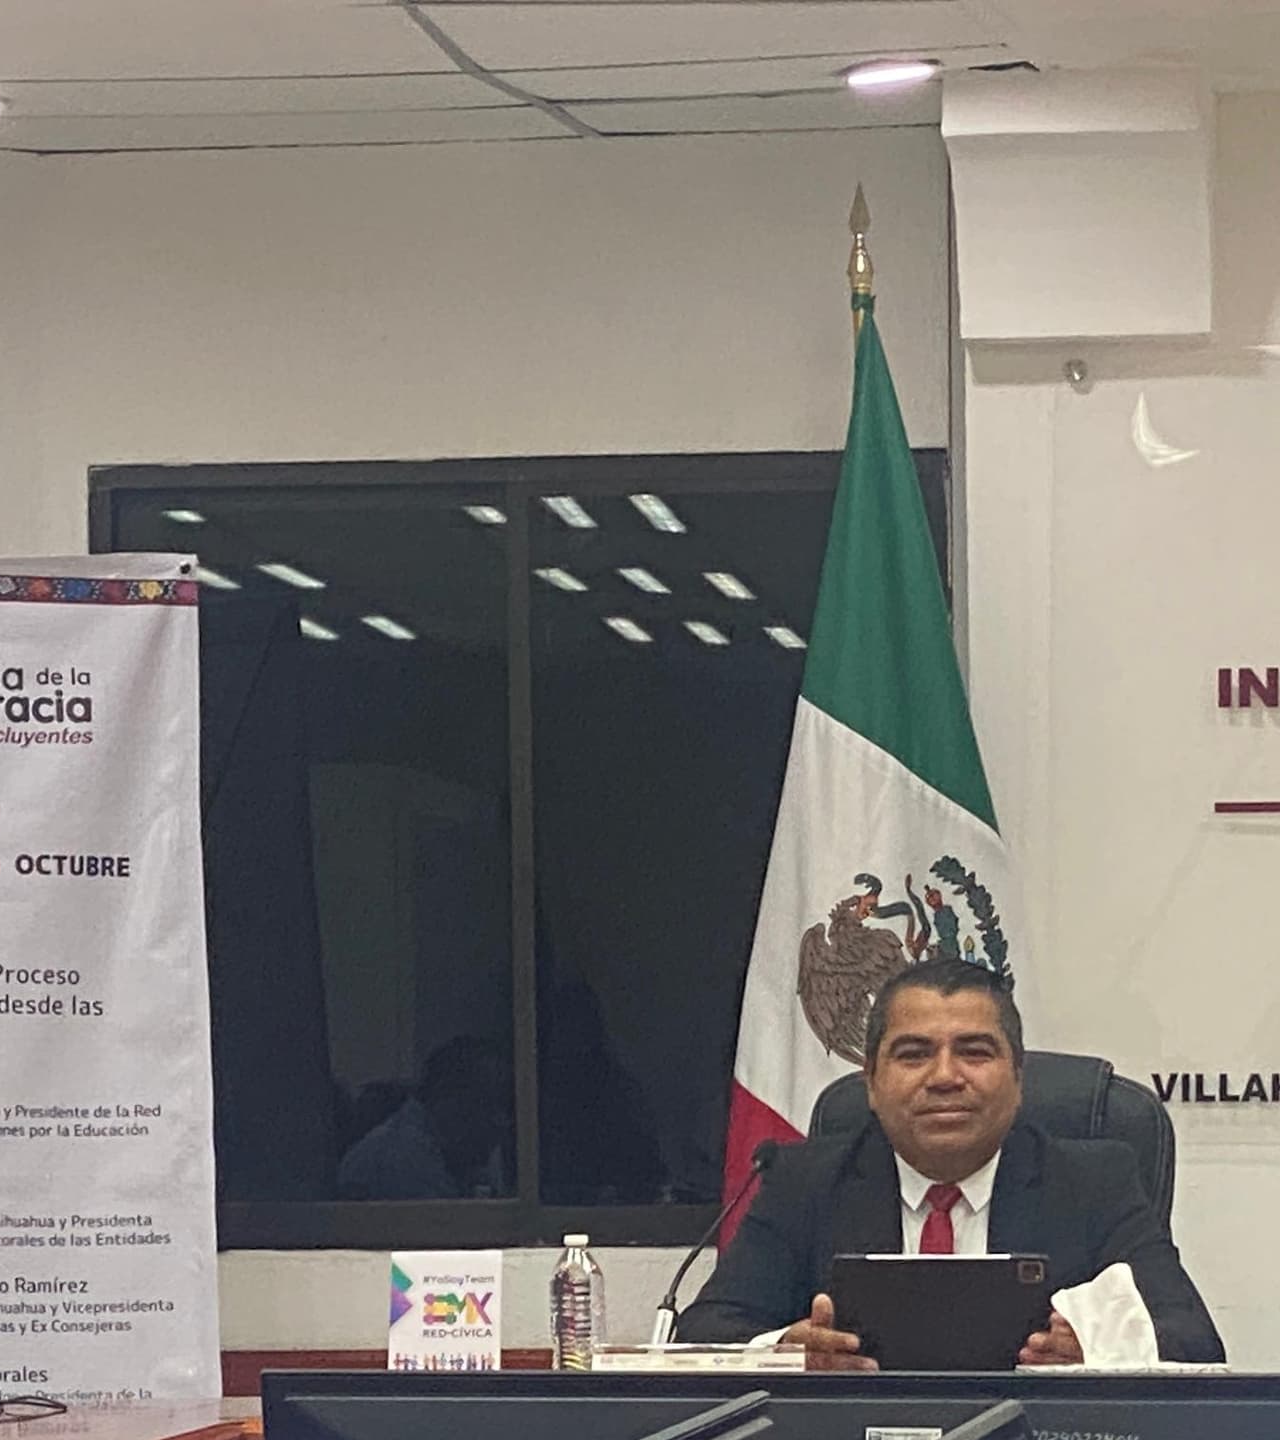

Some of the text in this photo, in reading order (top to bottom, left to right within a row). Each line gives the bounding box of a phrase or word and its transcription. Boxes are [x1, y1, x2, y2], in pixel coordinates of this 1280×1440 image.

[36, 667, 64, 687] de
[70, 667, 92, 687] la
[14, 854, 131, 878] OCTUBRE
[72, 996, 104, 1017] las
[4, 1107, 12, 1121] y
[15, 1104, 90, 1119] Presidente
[93, 1104, 112, 1119] de
[116, 1104, 130, 1118] la
[134, 1103, 161, 1118] Red
[29, 1125, 53, 1139] por
[57, 1124, 70, 1138] la
[74, 1123, 149, 1138] Educación
[59, 1216, 67, 1230] y
[71, 1214, 153, 1229] Presidenta
[14, 1276, 89, 1294] Ramírez
